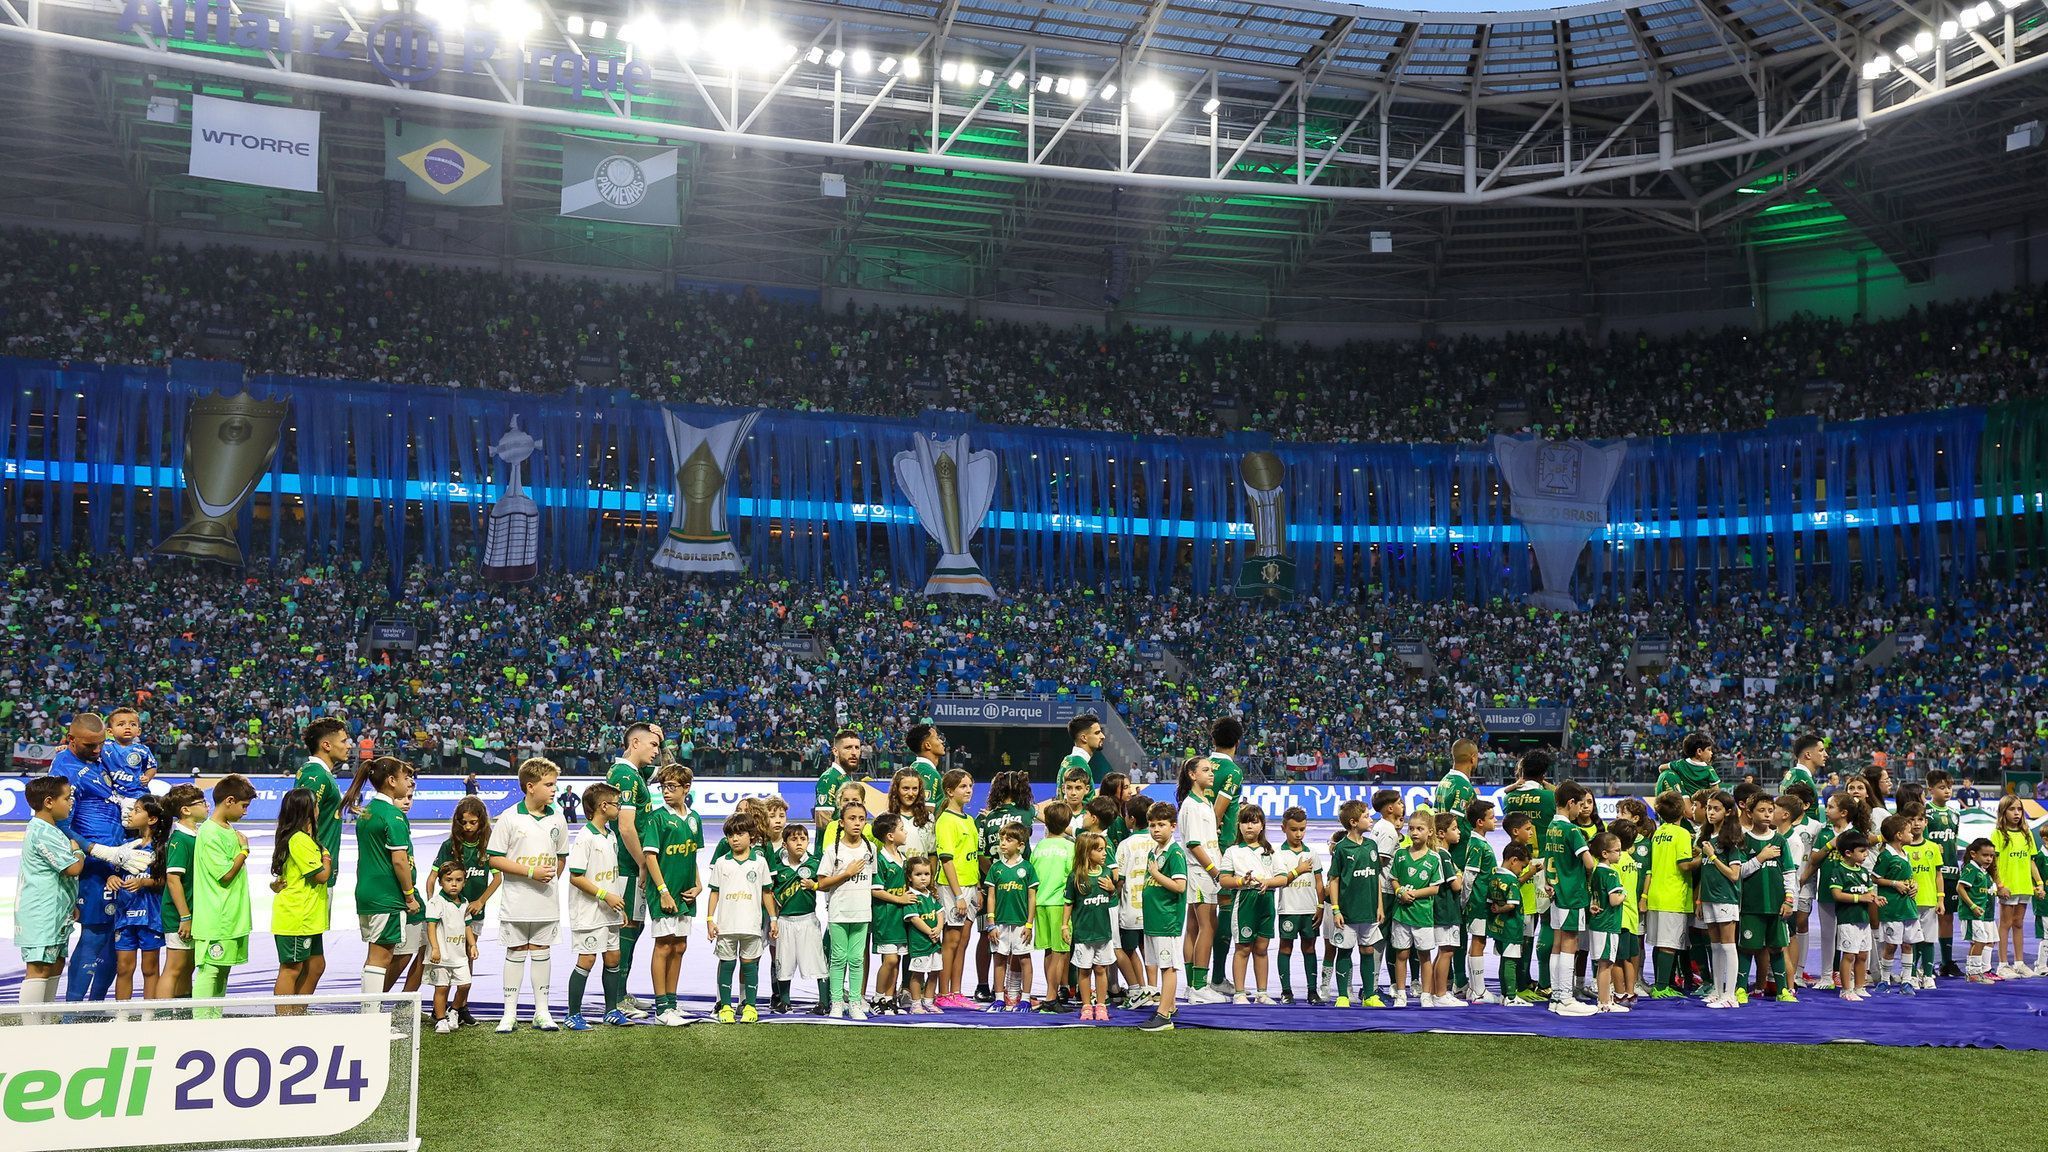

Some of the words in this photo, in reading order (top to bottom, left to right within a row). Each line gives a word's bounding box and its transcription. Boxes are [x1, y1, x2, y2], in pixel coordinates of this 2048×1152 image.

[202, 128, 310, 157] WTORRE
[597, 175, 645, 206] PALMEIRAS
[662, 547, 735, 562] BRASILEIRÃO
[934, 703, 980, 717] Allianz
[1001, 704, 1043, 721] Parque
[1485, 714, 1520, 724] Allianz
[1507, 793, 1541, 806] crefisa
[986, 813, 1023, 828] crefisa
[1652, 833, 1673, 846] refisa
[2009, 850, 2029, 859] crefis
[465, 866, 485, 878] fisa
[594, 866, 619, 883] crefi
[1911, 864, 1931, 874] efisa
[997, 880, 1023, 892] crefisa
[725, 891, 753, 901] crefisa
[1083, 894, 1110, 906] crefisa
[0, 1045, 157, 1124] edi
[174, 1044, 369, 1112] 2024
